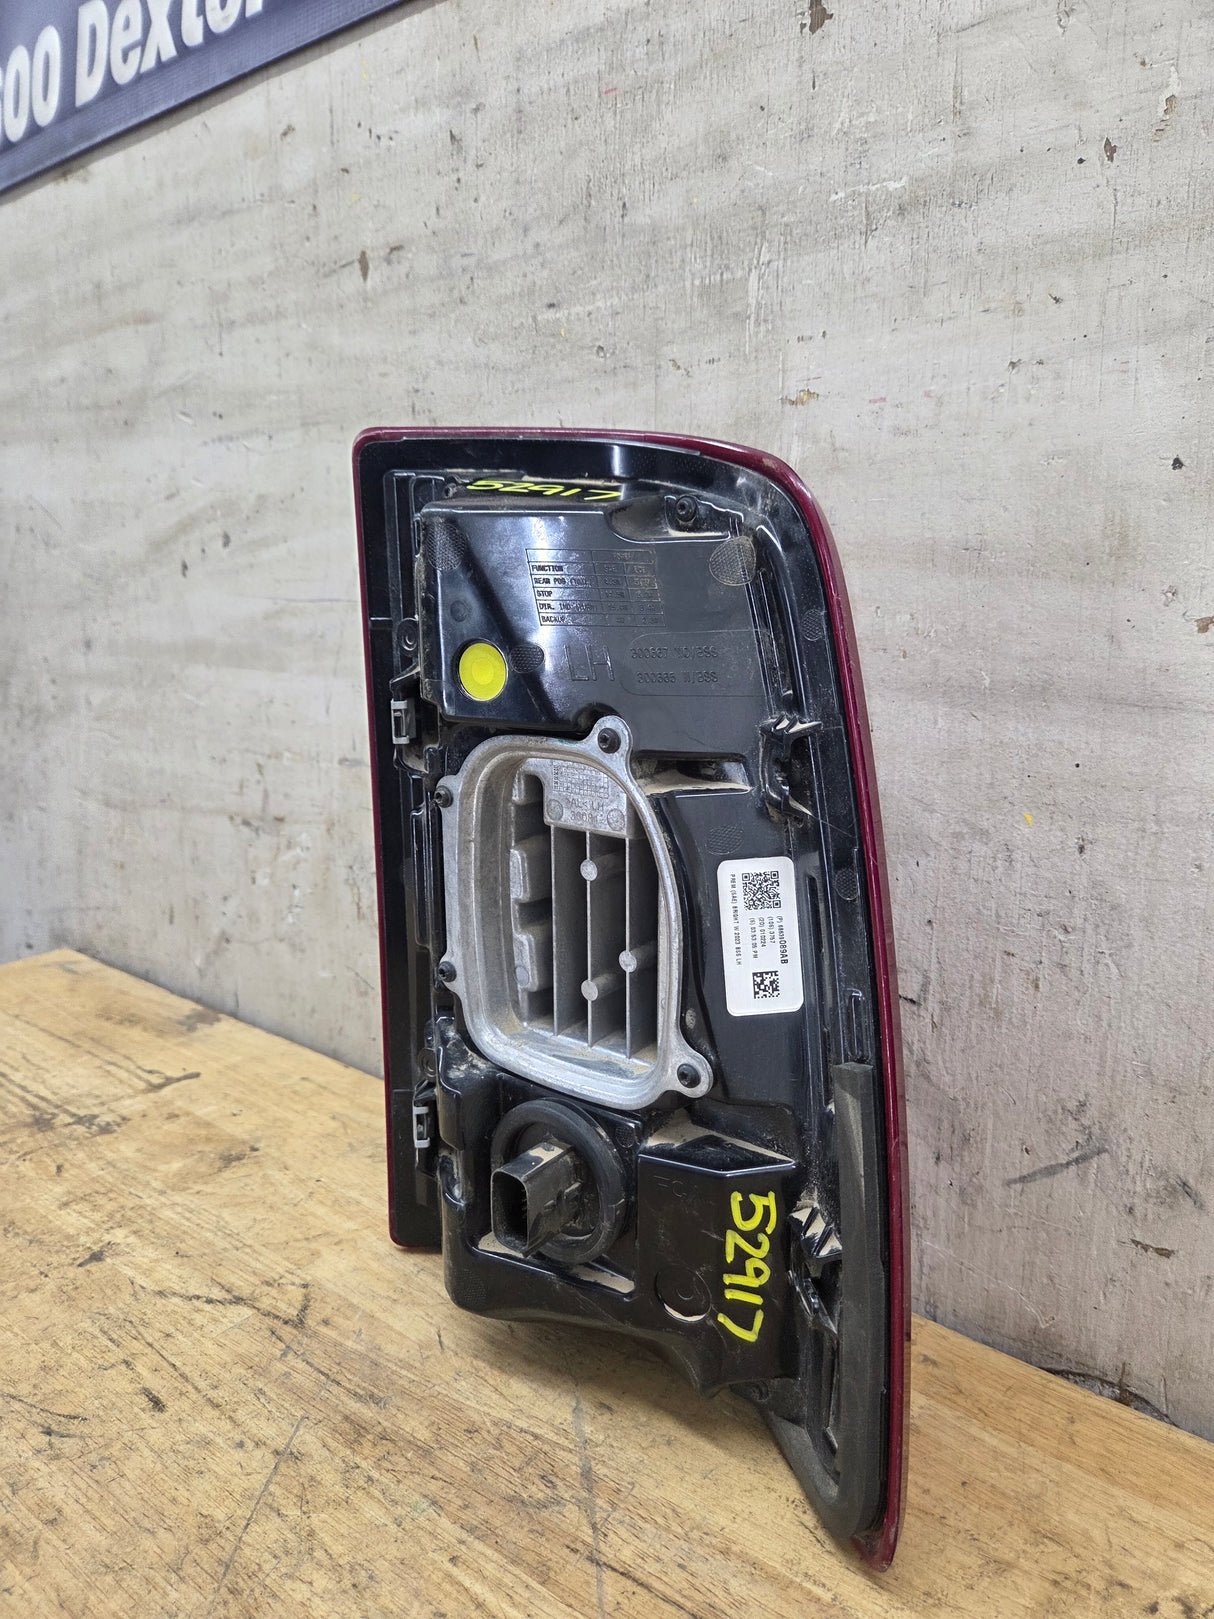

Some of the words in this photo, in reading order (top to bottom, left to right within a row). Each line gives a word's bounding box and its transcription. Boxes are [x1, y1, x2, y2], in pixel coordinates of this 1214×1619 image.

[0, 26, 62, 145] 00
[75, 0, 263, 108] Dext
[466, 480, 622, 501] 52917
[531, 565, 564, 573] FUNCTION
[536, 590, 553, 598] STOP
[717, 1190, 777, 1343] 52917
